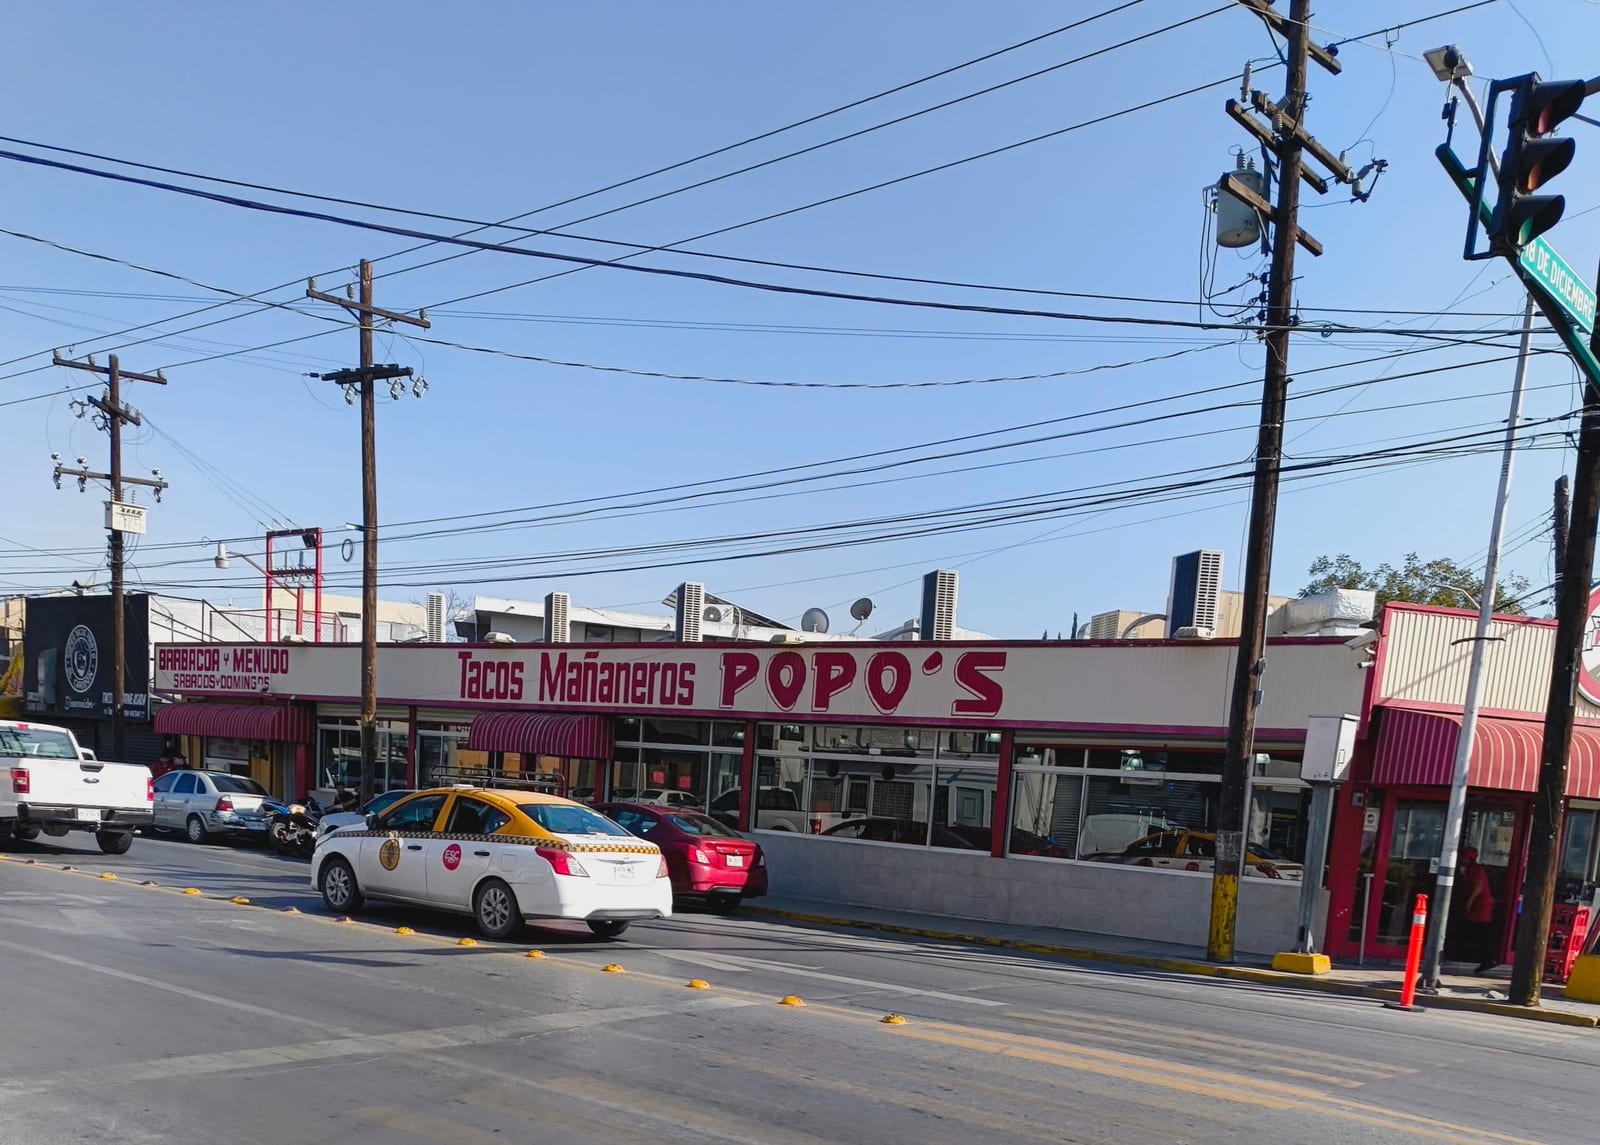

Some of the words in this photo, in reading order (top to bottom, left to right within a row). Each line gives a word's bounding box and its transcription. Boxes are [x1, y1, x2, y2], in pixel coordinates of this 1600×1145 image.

[1536, 246, 1550, 278] DE
[1550, 260, 1594, 323] DICIEMBRE
[159, 649, 219, 671] BARBACOA
[233, 649, 288, 674] MENUDO
[174, 673, 215, 688] SABADOS
[458, 651, 524, 700] Tacos
[539, 651, 695, 706] Mañaneros
[719, 651, 1007, 717] POPO'S
